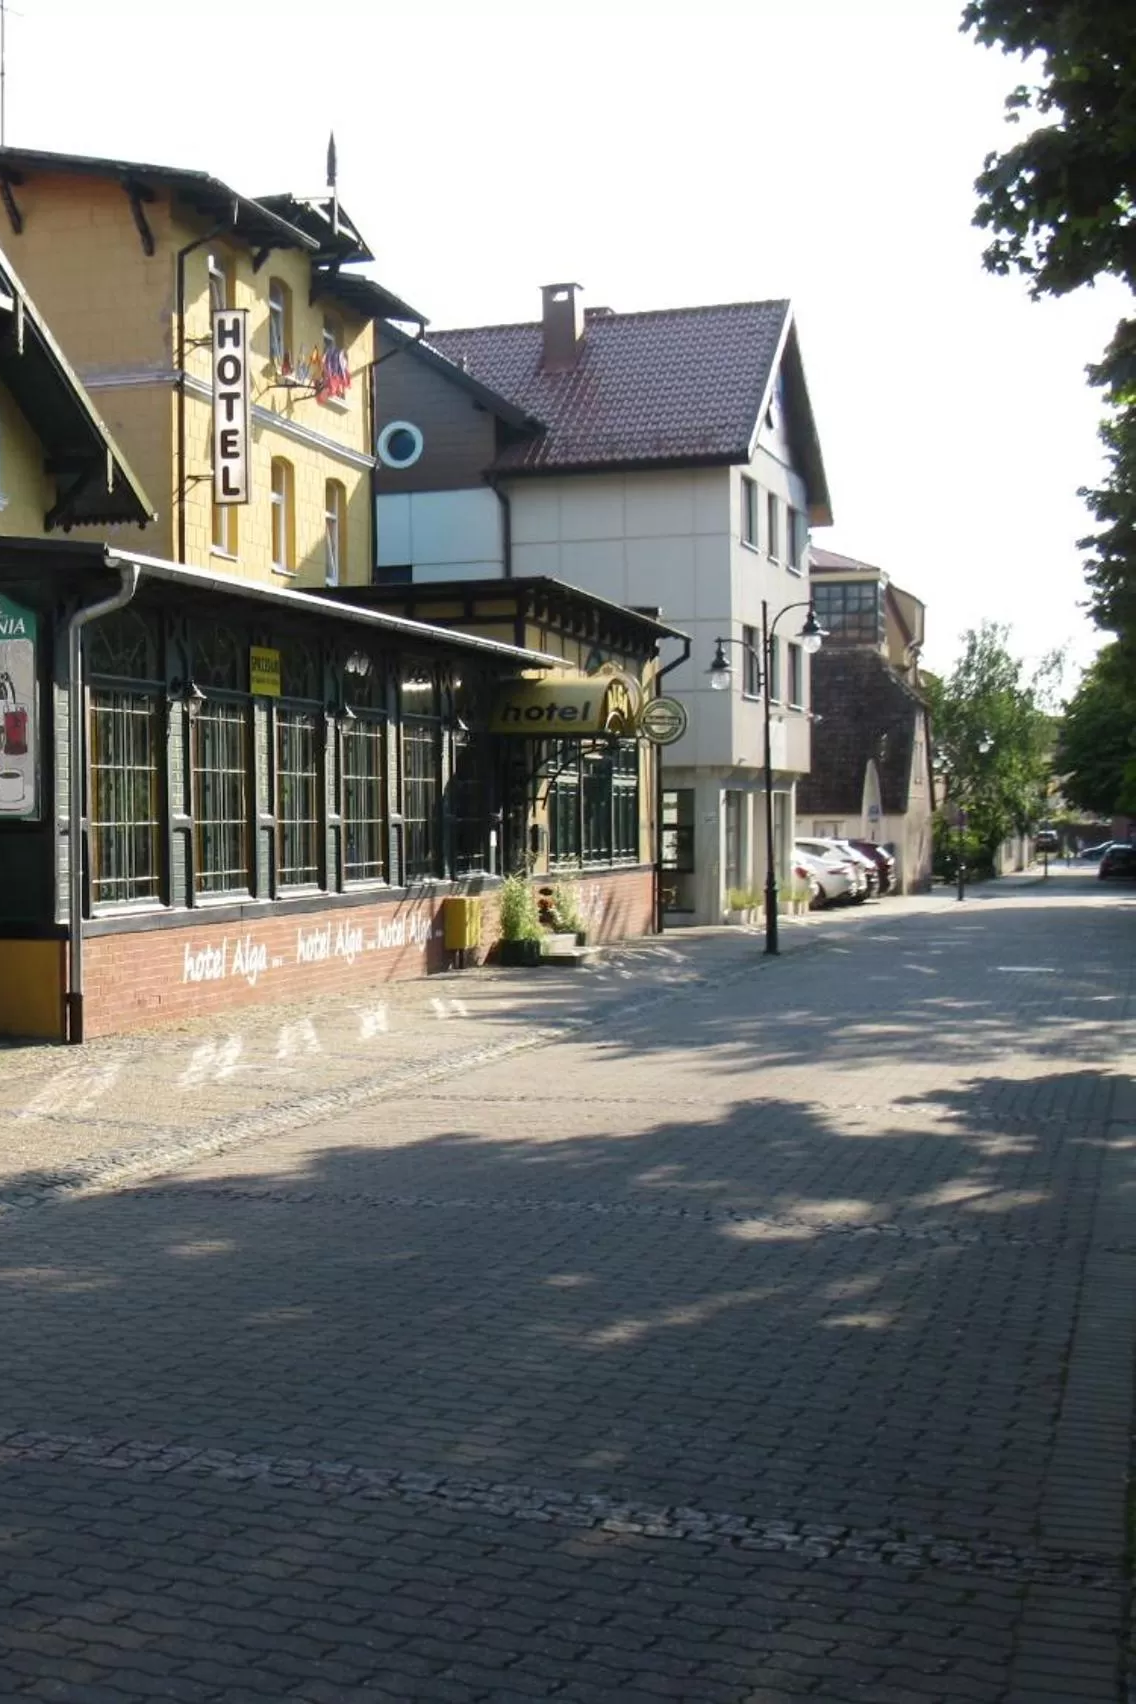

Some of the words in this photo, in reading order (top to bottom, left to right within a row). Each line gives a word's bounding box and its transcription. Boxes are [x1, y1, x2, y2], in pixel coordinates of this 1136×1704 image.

[217, 317, 242, 496] HOTEL
[501, 701, 591, 722] hotel
[182, 936, 227, 984] hotel
[231, 933, 267, 986] Alga
[297, 920, 331, 964] hotel
[335, 917, 363, 964] Alga
[378, 911, 406, 948] hotel
[409, 910, 432, 952] Alga
